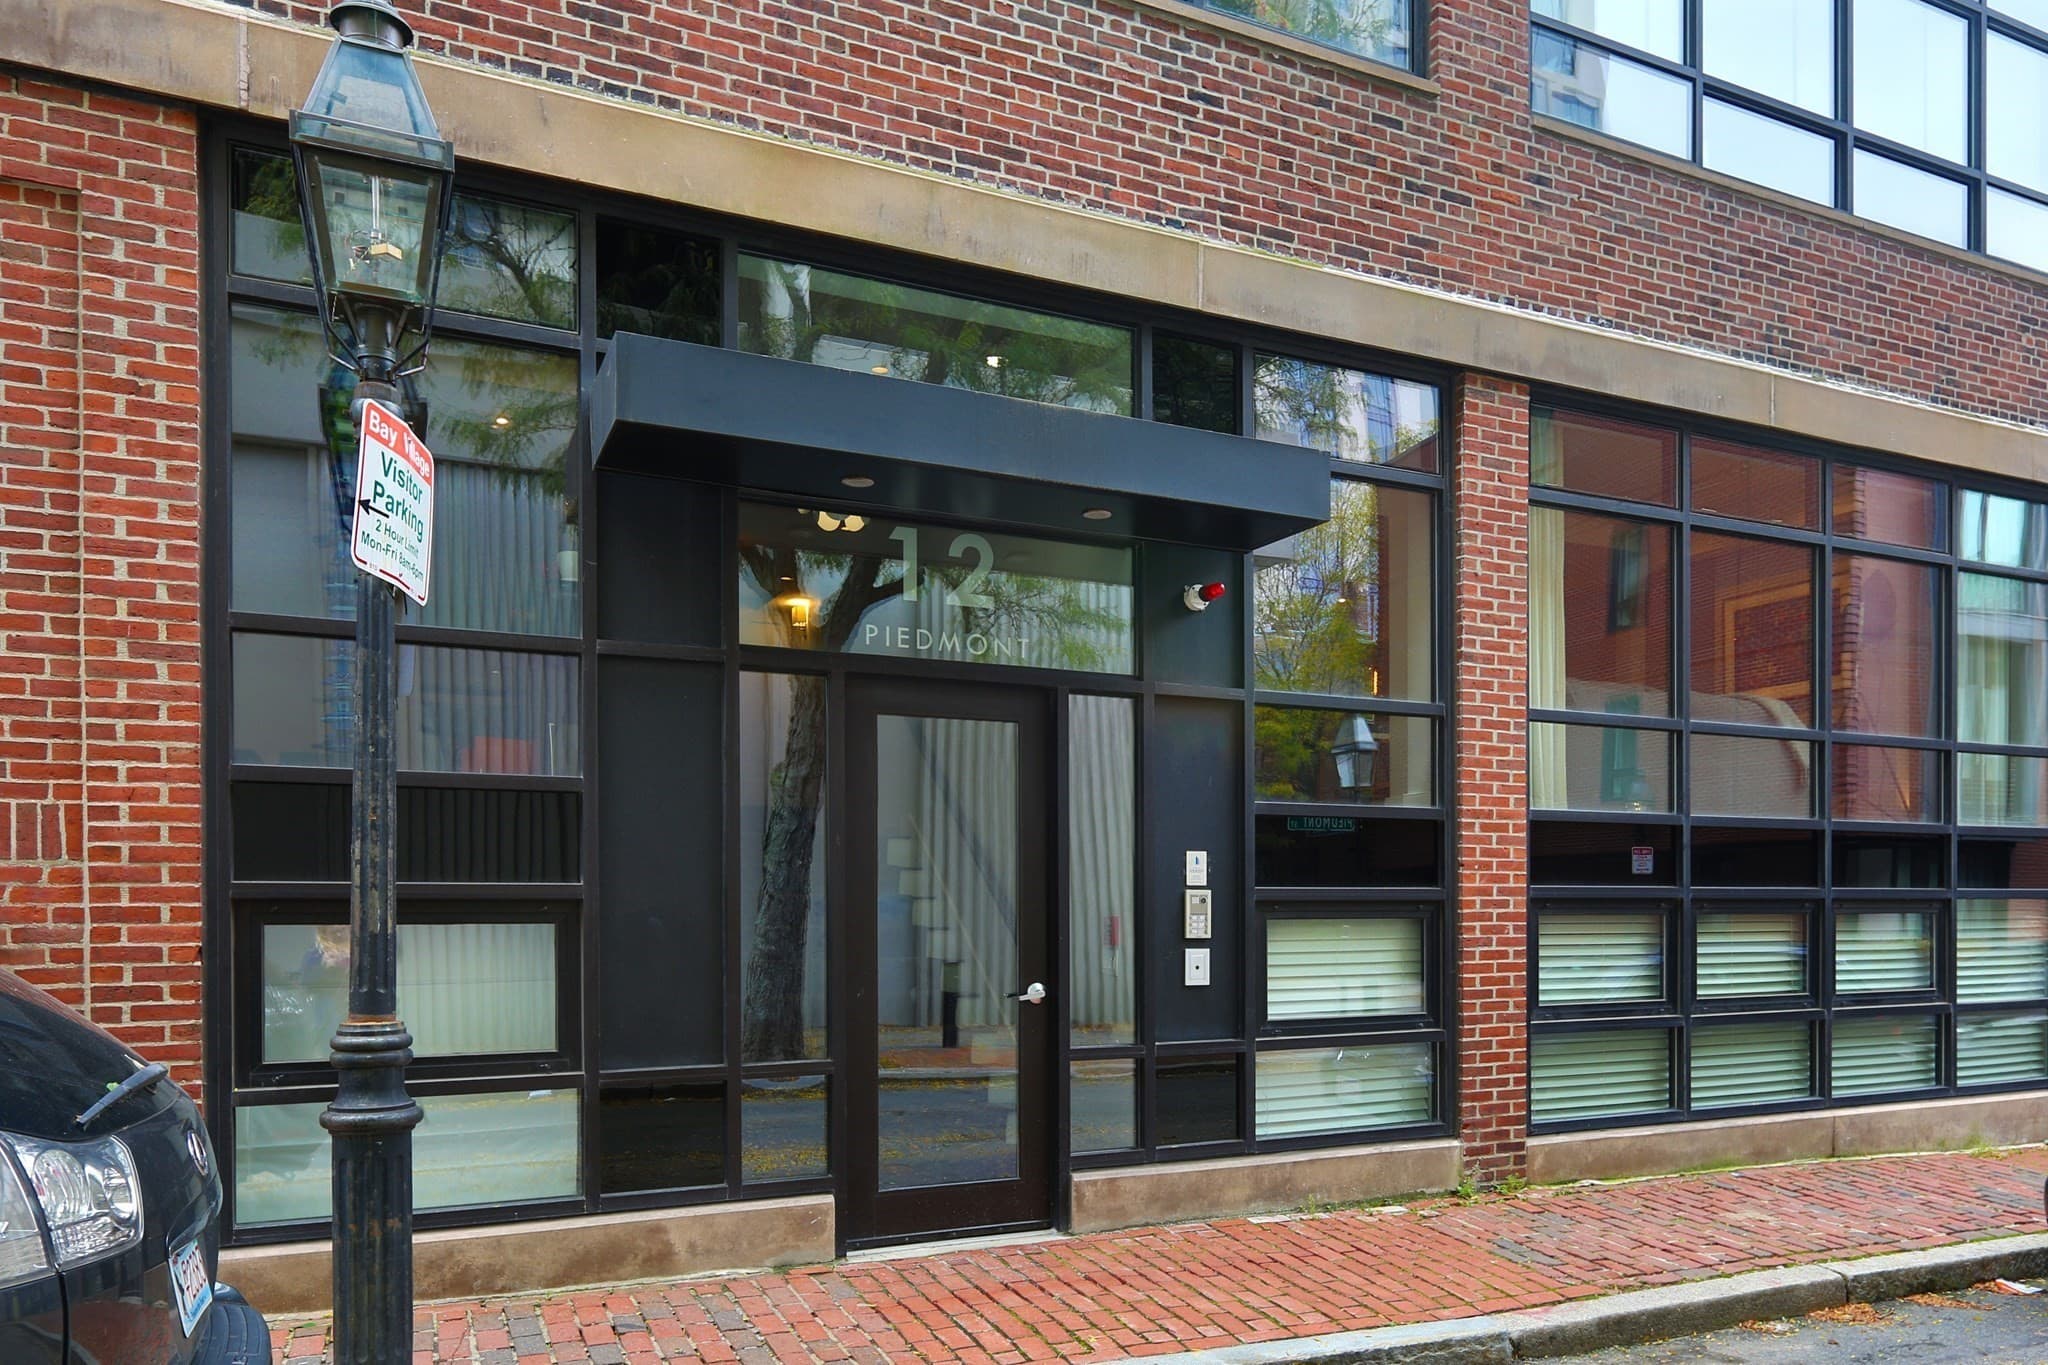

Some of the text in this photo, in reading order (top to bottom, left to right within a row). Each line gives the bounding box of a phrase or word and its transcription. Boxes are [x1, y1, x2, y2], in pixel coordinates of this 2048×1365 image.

[369, 409, 398, 448] Bay
[381, 451, 423, 505] Visitor
[373, 479, 424, 543] Parking
[361, 530, 398, 561] Mon-Fri
[375, 519, 382, 533] 2
[384, 523, 404, 546] Hour
[889, 526, 995, 610] 12
[865, 623, 1030, 659] PIEDMONT
